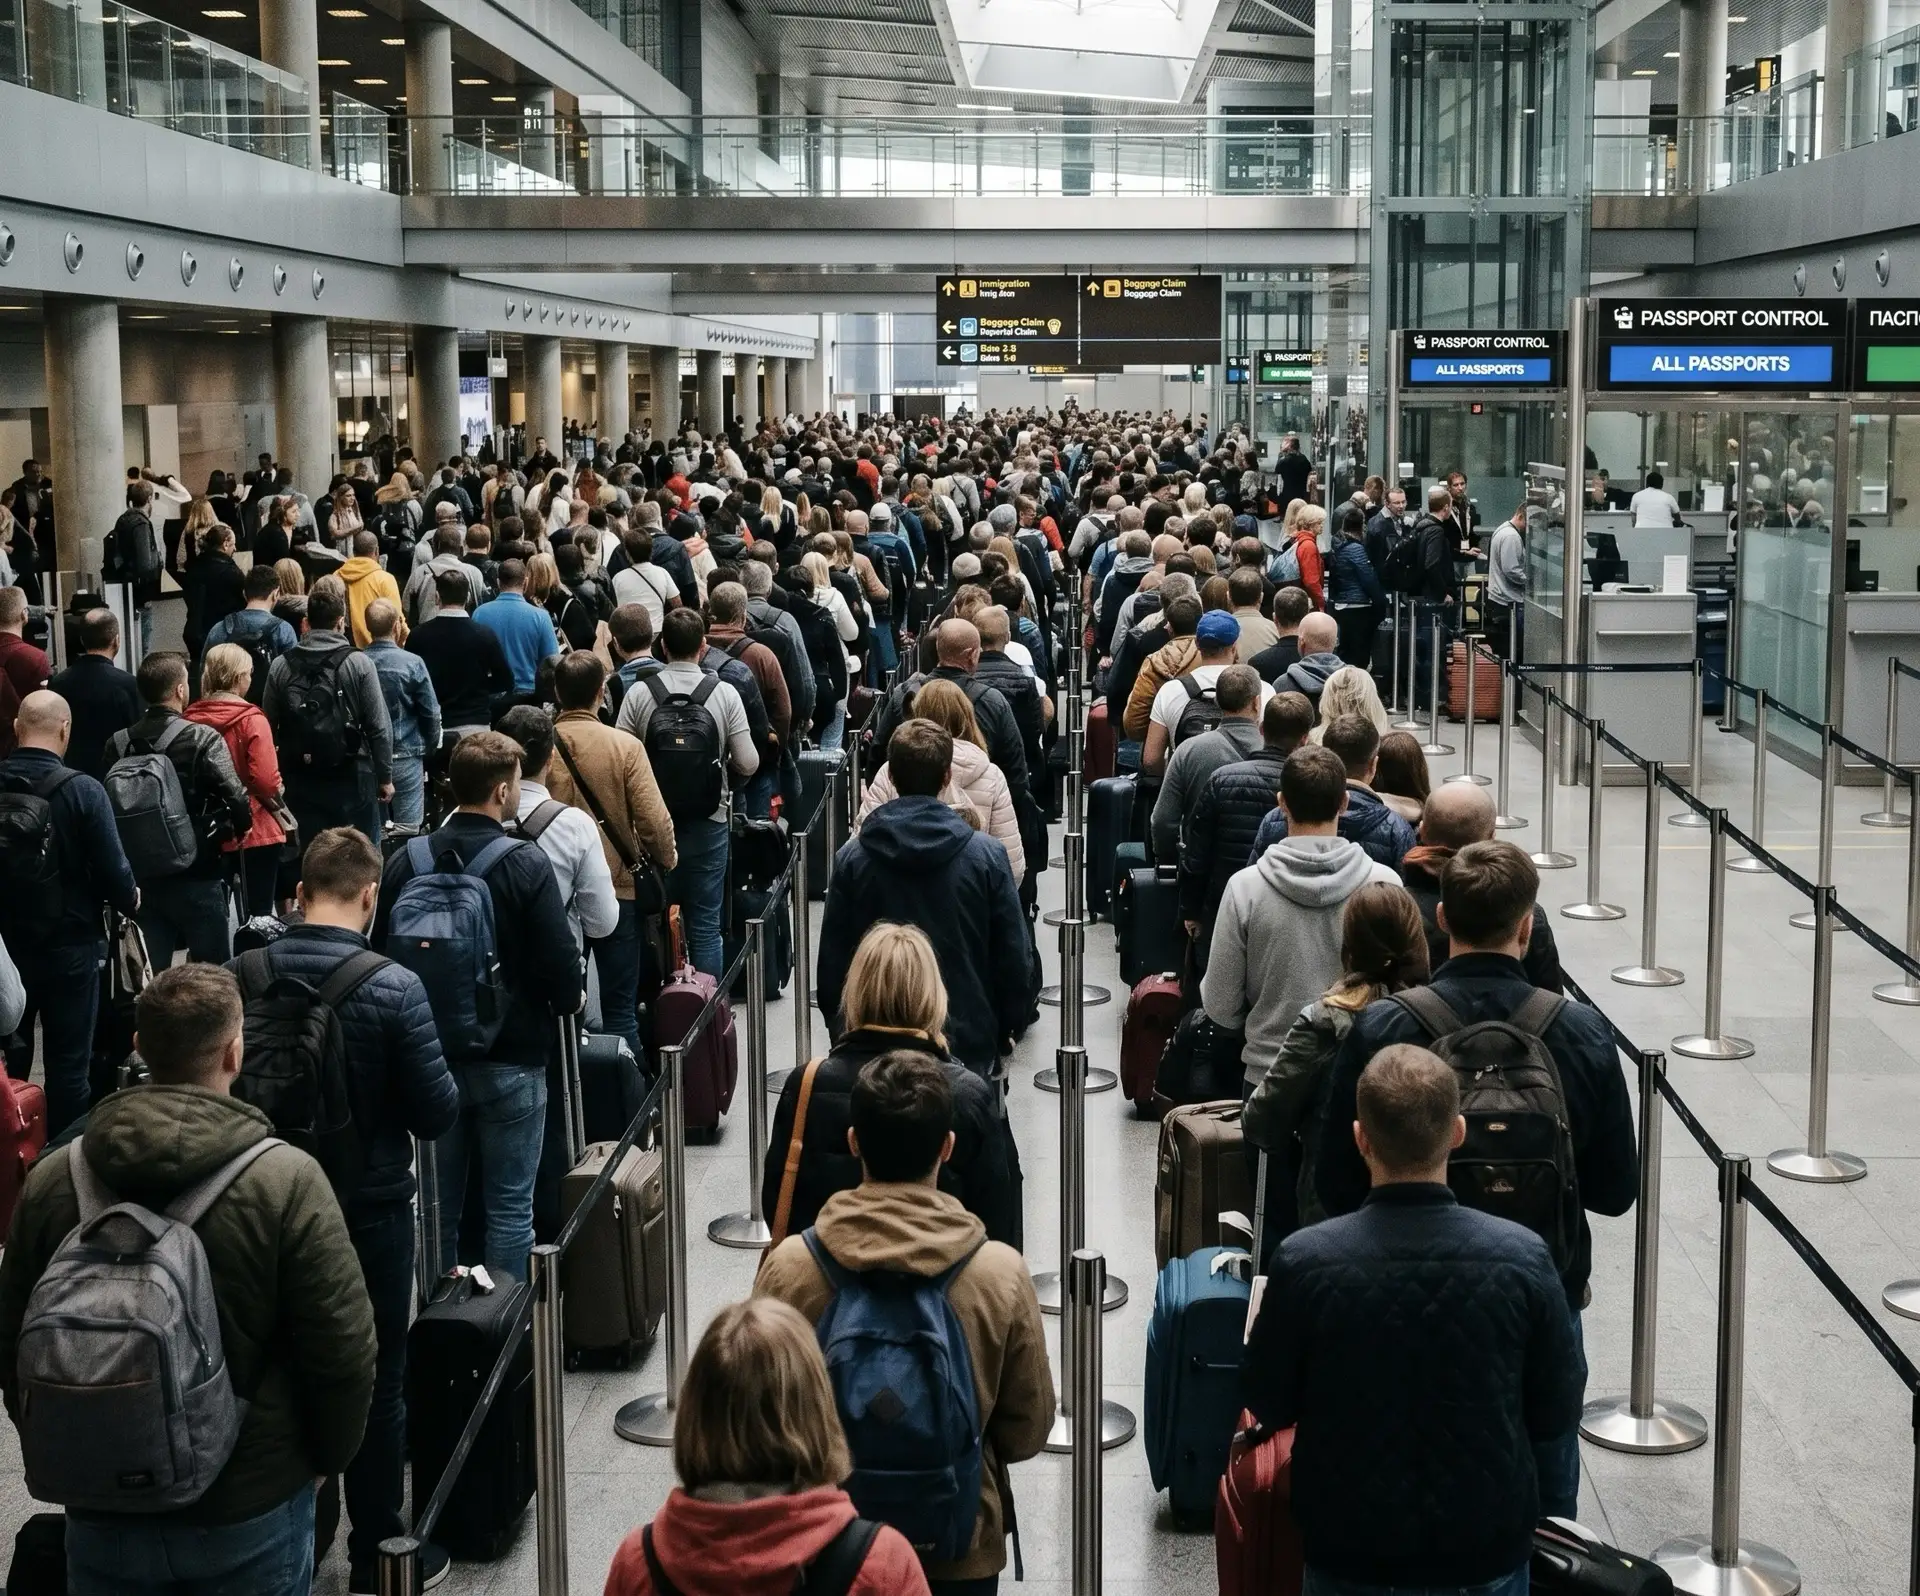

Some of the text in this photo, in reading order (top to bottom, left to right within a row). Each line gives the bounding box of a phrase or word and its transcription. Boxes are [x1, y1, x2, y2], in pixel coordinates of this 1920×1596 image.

[979, 279, 1031, 290] Immigration
[1161, 279, 1187, 288] Claim
[1159, 289, 1182, 298] Claim
[1020, 317, 1046, 327] Claim
[1641, 310, 1829, 326] PASSPORT CONTROL
[1870, 310, 1920, 326] ПАСП
[1431, 337, 1550, 349] PASSPORT CONTROL
[1651, 356, 1790, 371] ALL PASSPORTS
[1435, 364, 1525, 375] ALL PASSPORTS
